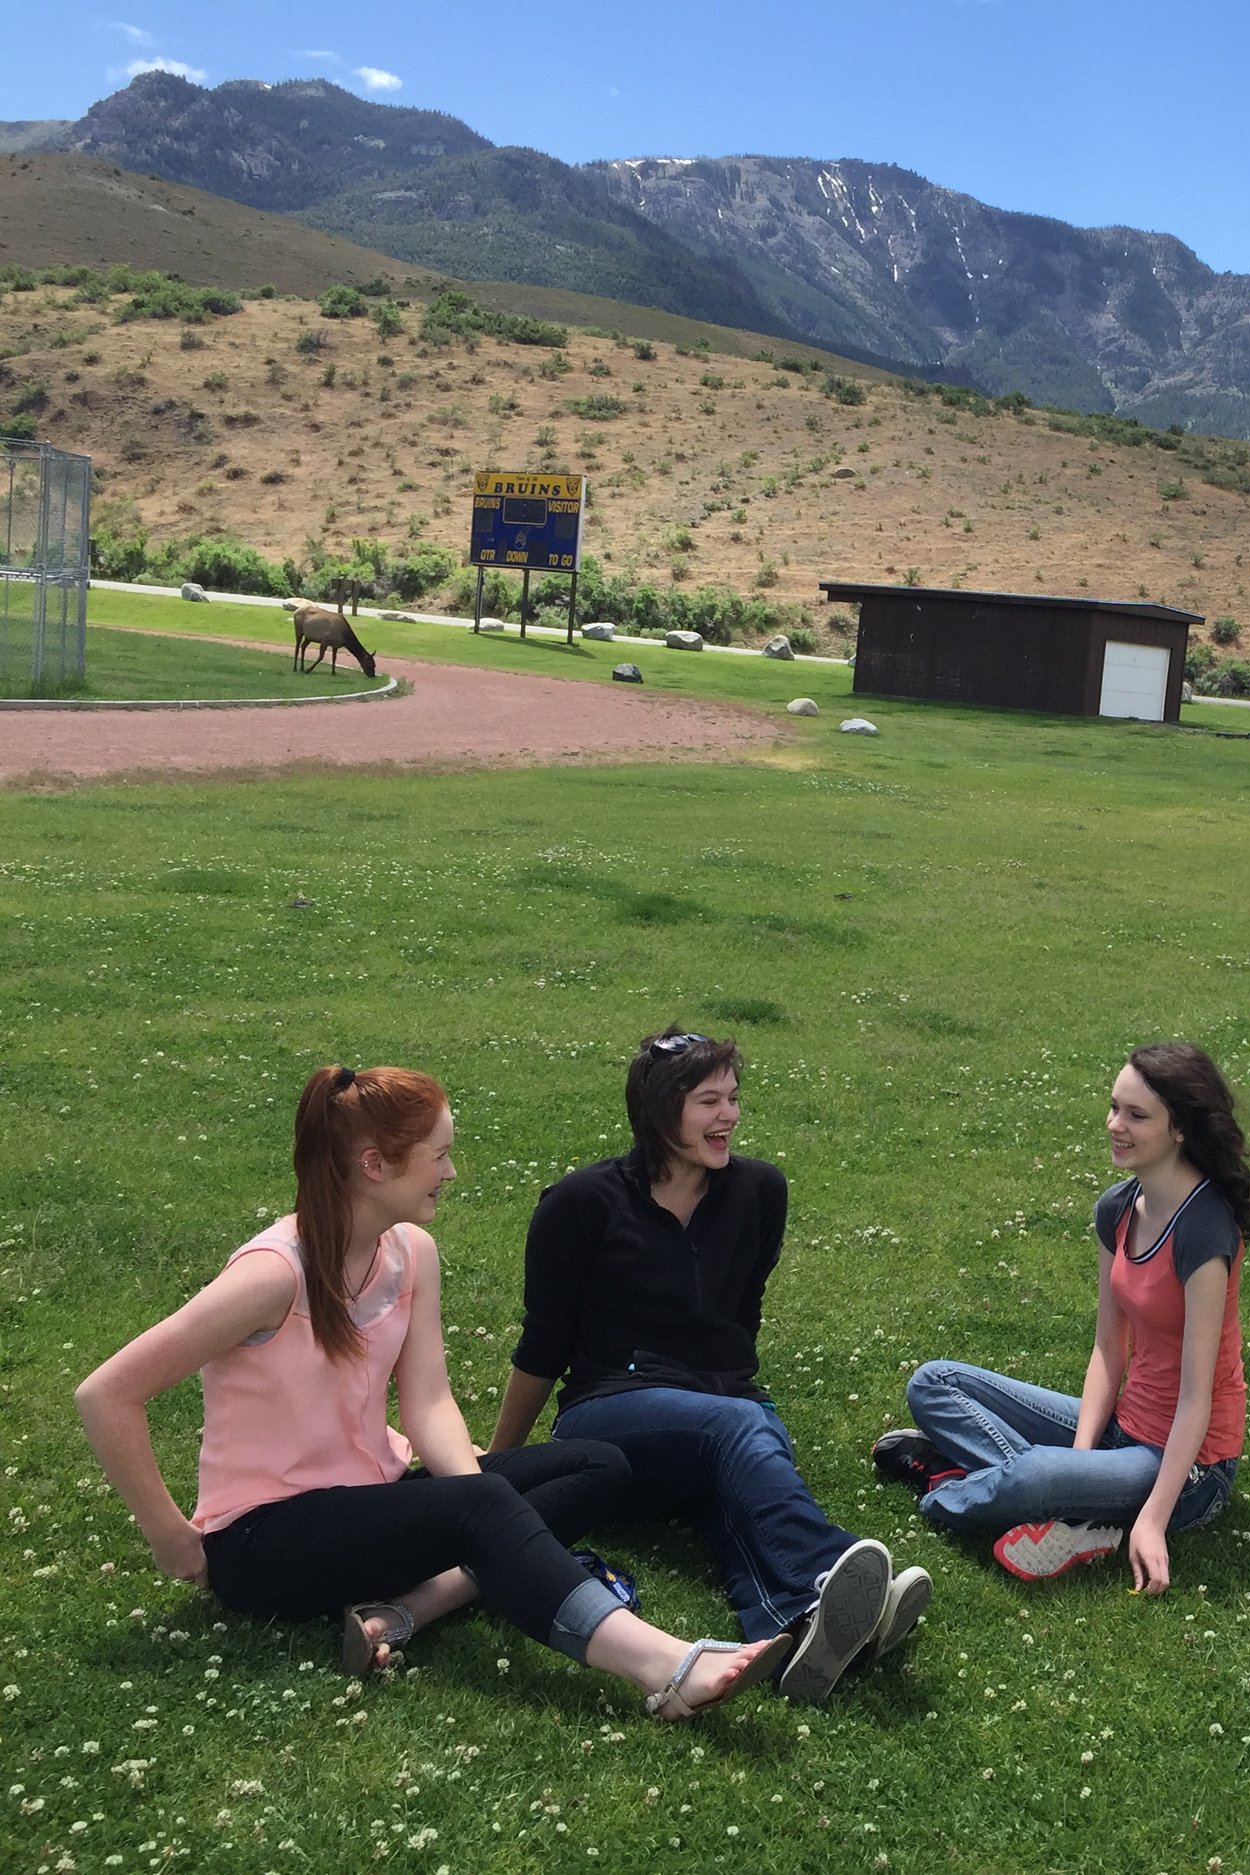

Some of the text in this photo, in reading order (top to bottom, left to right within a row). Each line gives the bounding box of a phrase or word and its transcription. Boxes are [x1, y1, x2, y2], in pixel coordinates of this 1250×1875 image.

[494, 482, 561, 496] BRUINS
[548, 501, 579, 513] VISITOR
[506, 550, 528, 563] DOWN
[549, 554, 573, 567] TO GO
